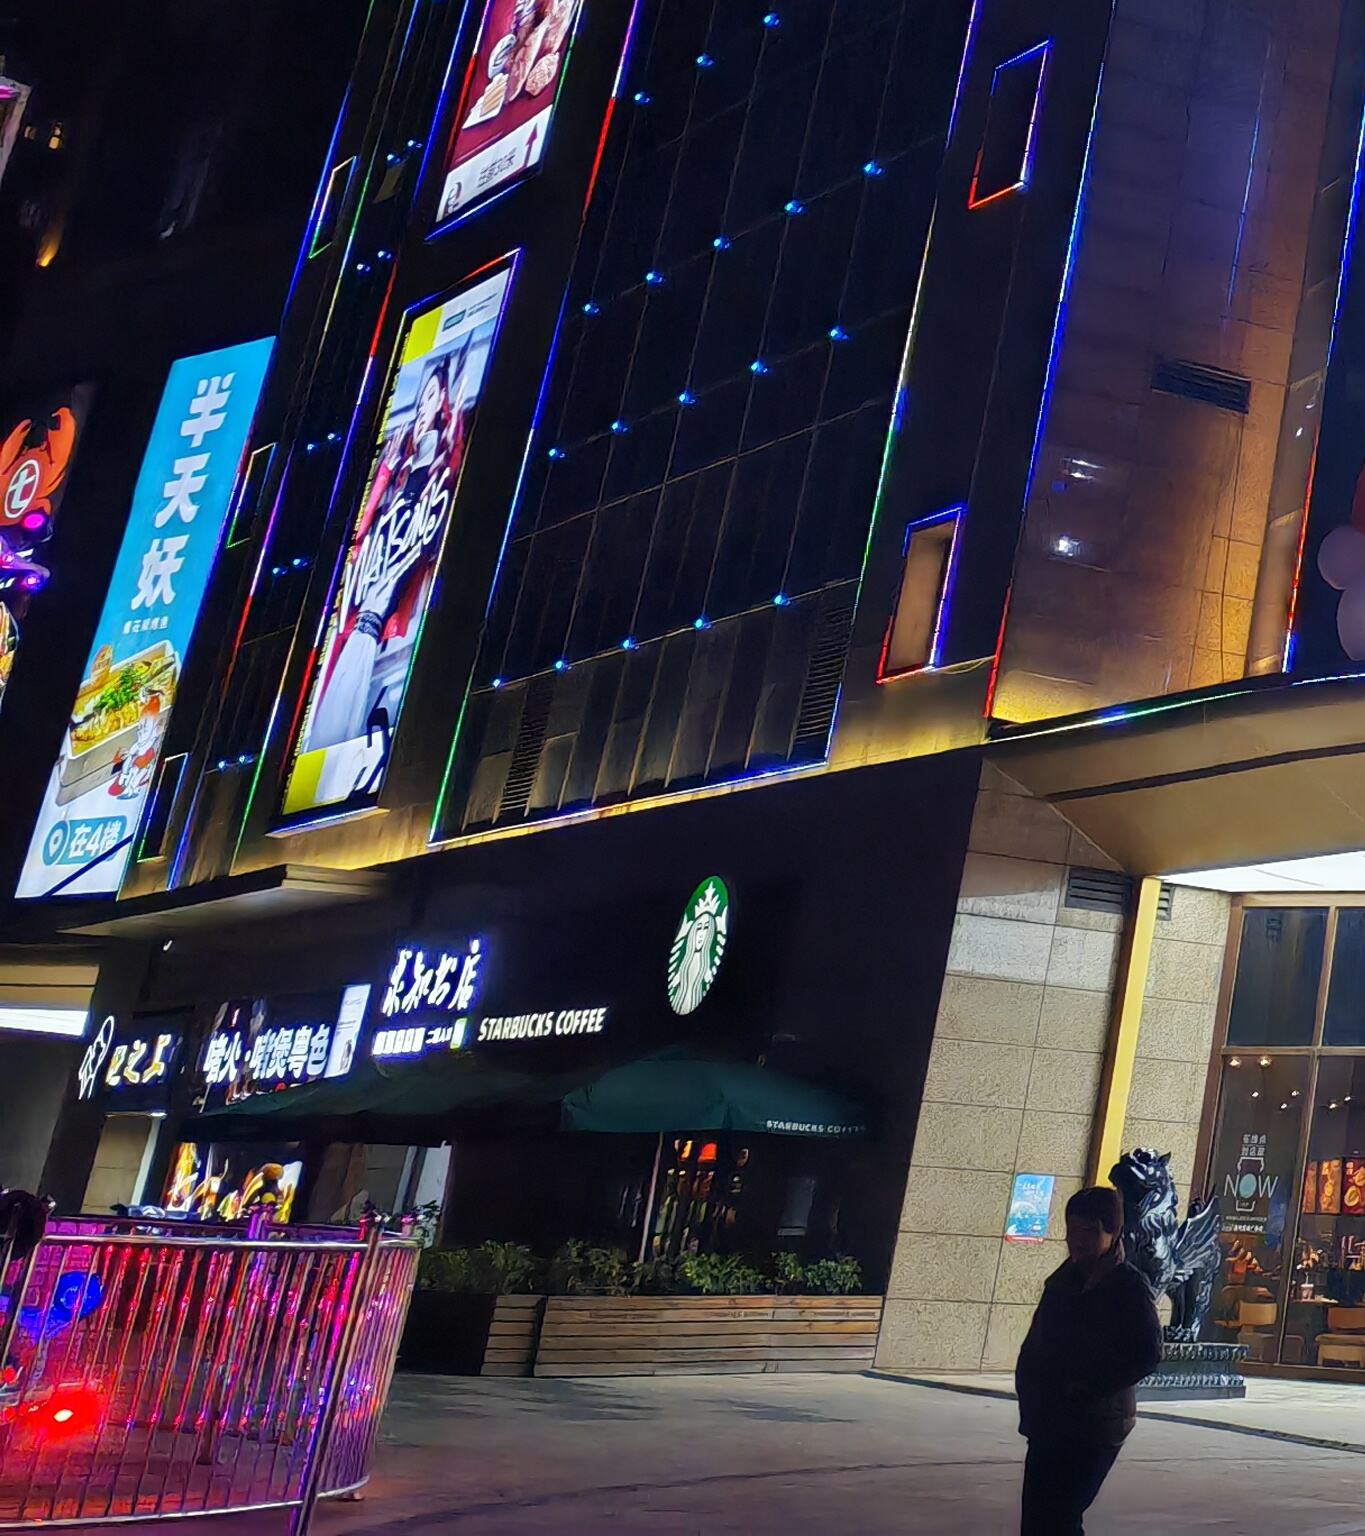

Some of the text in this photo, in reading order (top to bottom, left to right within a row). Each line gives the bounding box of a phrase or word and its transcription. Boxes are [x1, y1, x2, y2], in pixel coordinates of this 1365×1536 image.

[131, 373, 236, 610] 半天妖
[477, 1014, 552, 1041] STARBUCKS
[555, 1007, 608, 1035] COFFEE
